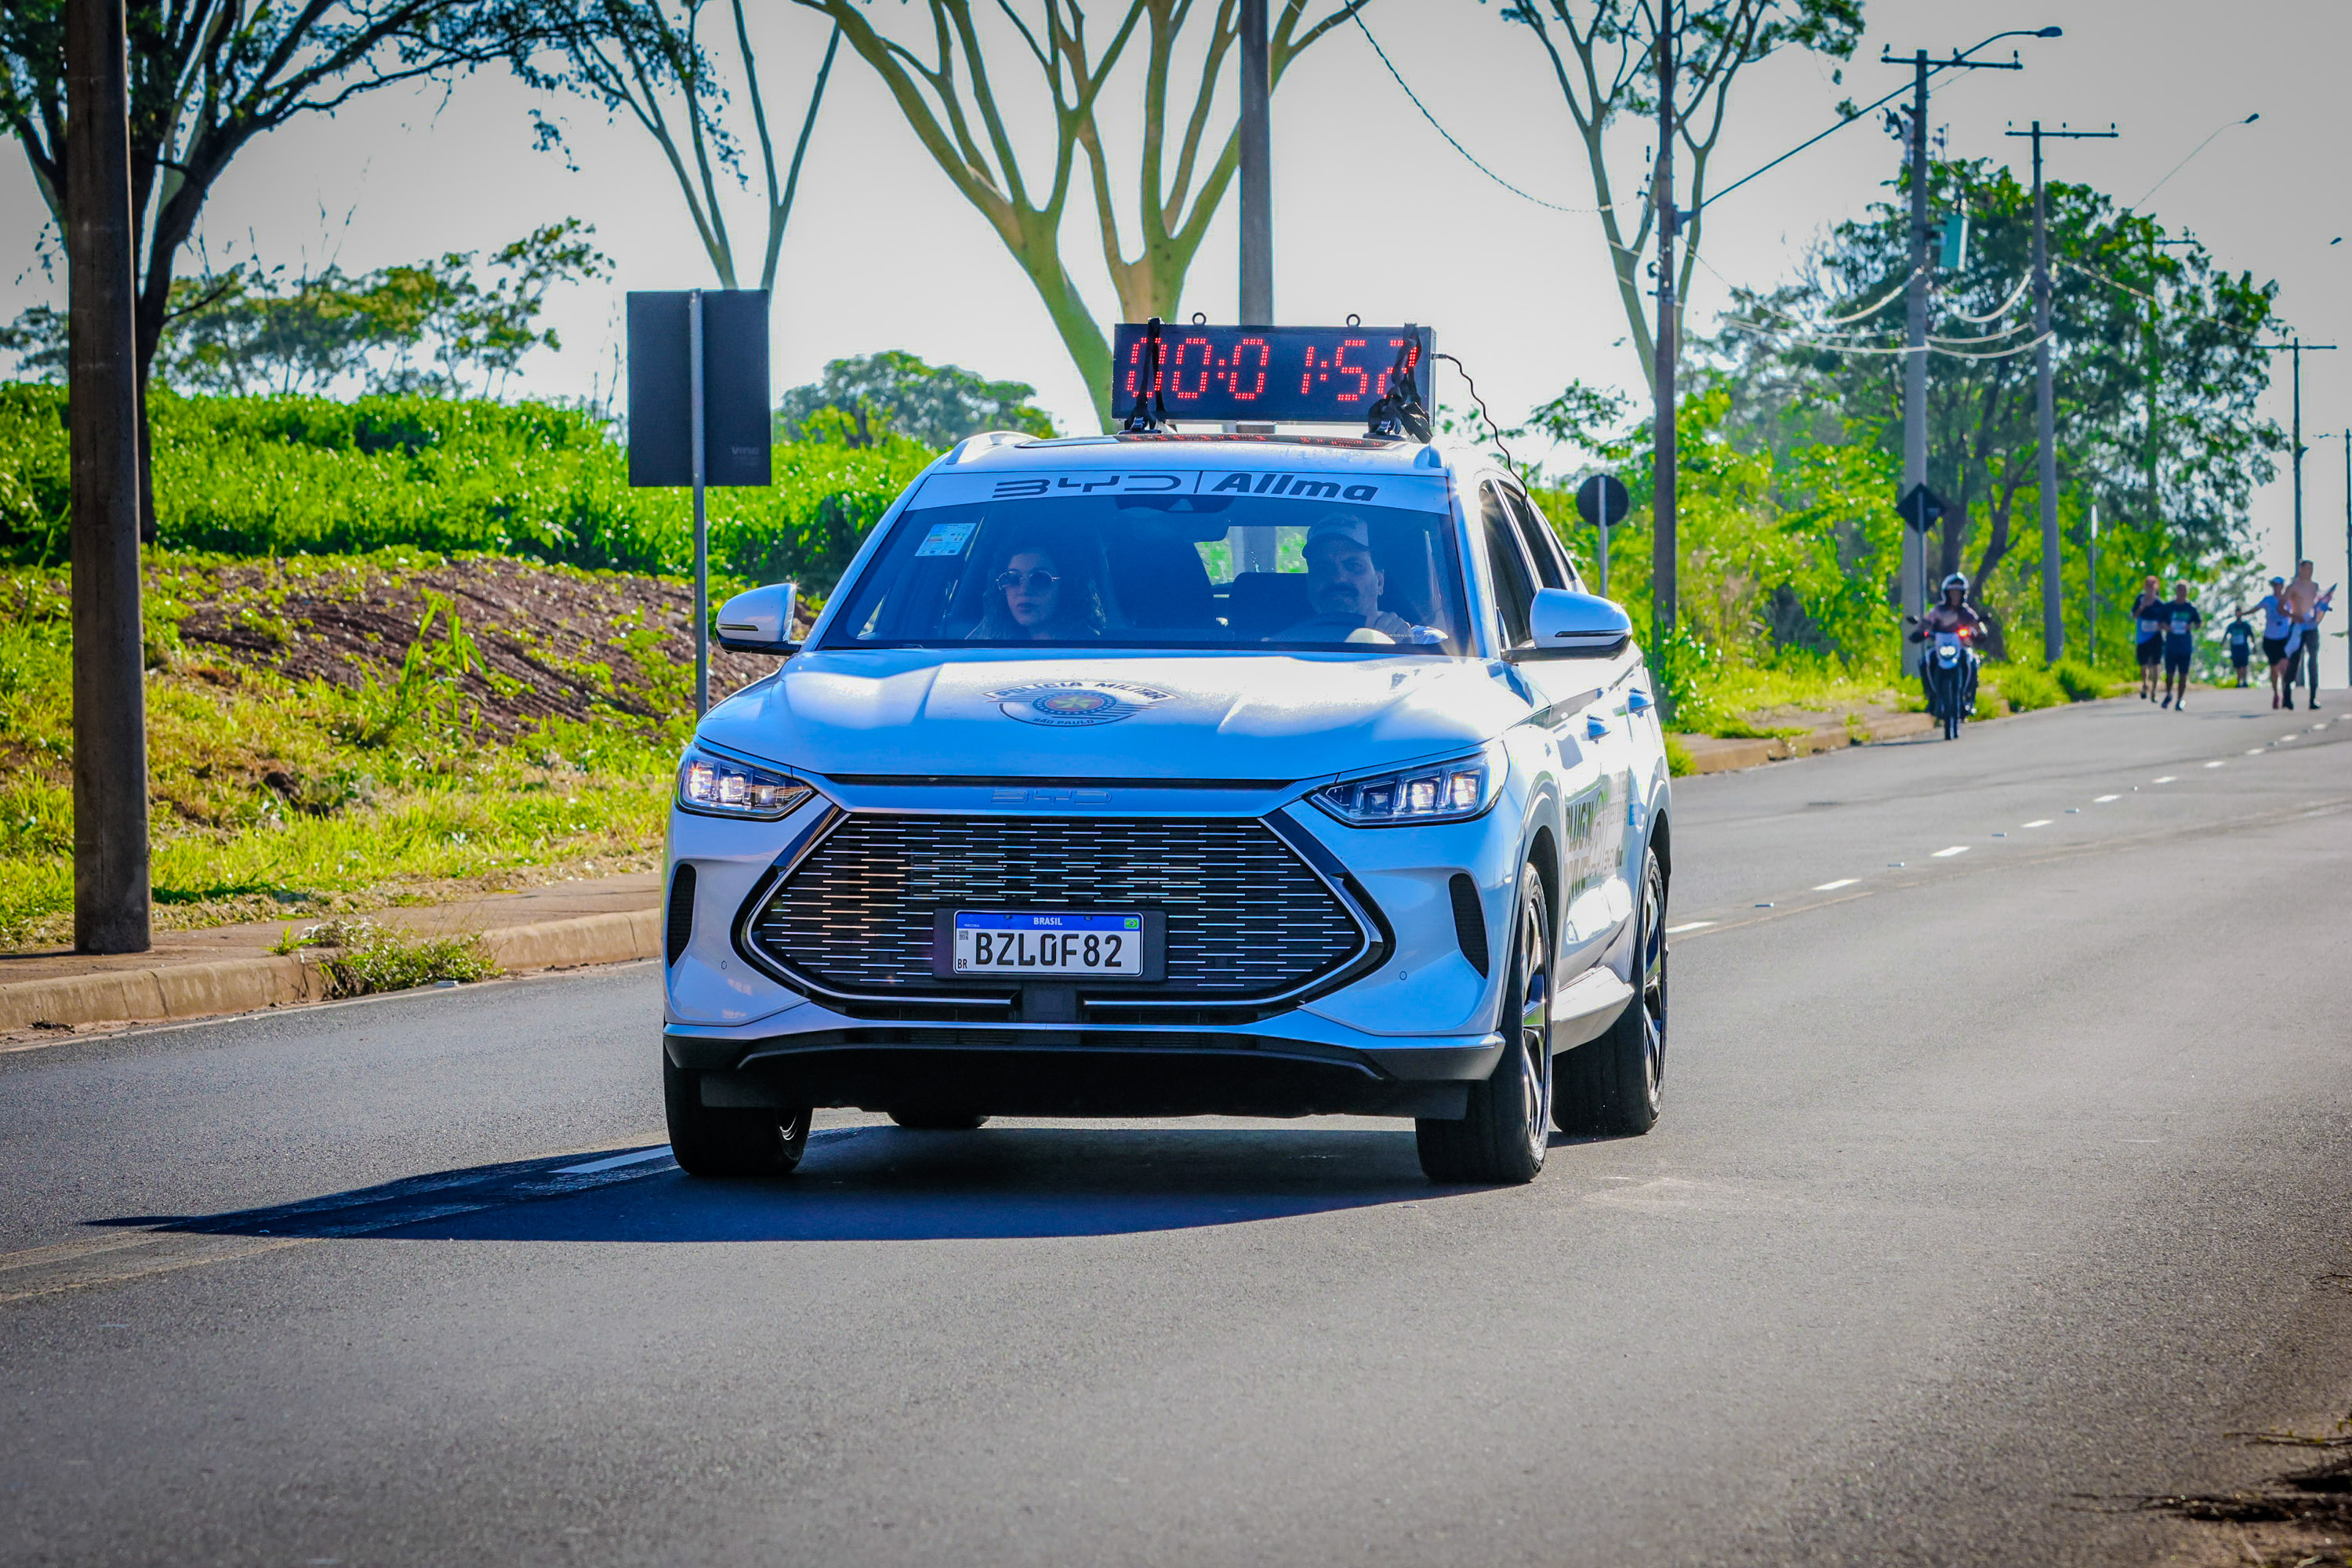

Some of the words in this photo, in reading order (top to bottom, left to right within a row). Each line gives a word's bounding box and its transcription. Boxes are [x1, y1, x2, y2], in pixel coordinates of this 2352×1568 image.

[992, 474, 1182, 499] BYD
[1210, 472, 1380, 502] Allma
[996, 681, 1083, 697] POLÍCIA
[1094, 682, 1168, 700] MILITAR
[990, 789, 1113, 804] BYD
[1033, 916, 1063, 927] BRASIL
[957, 958, 967, 969] BR
